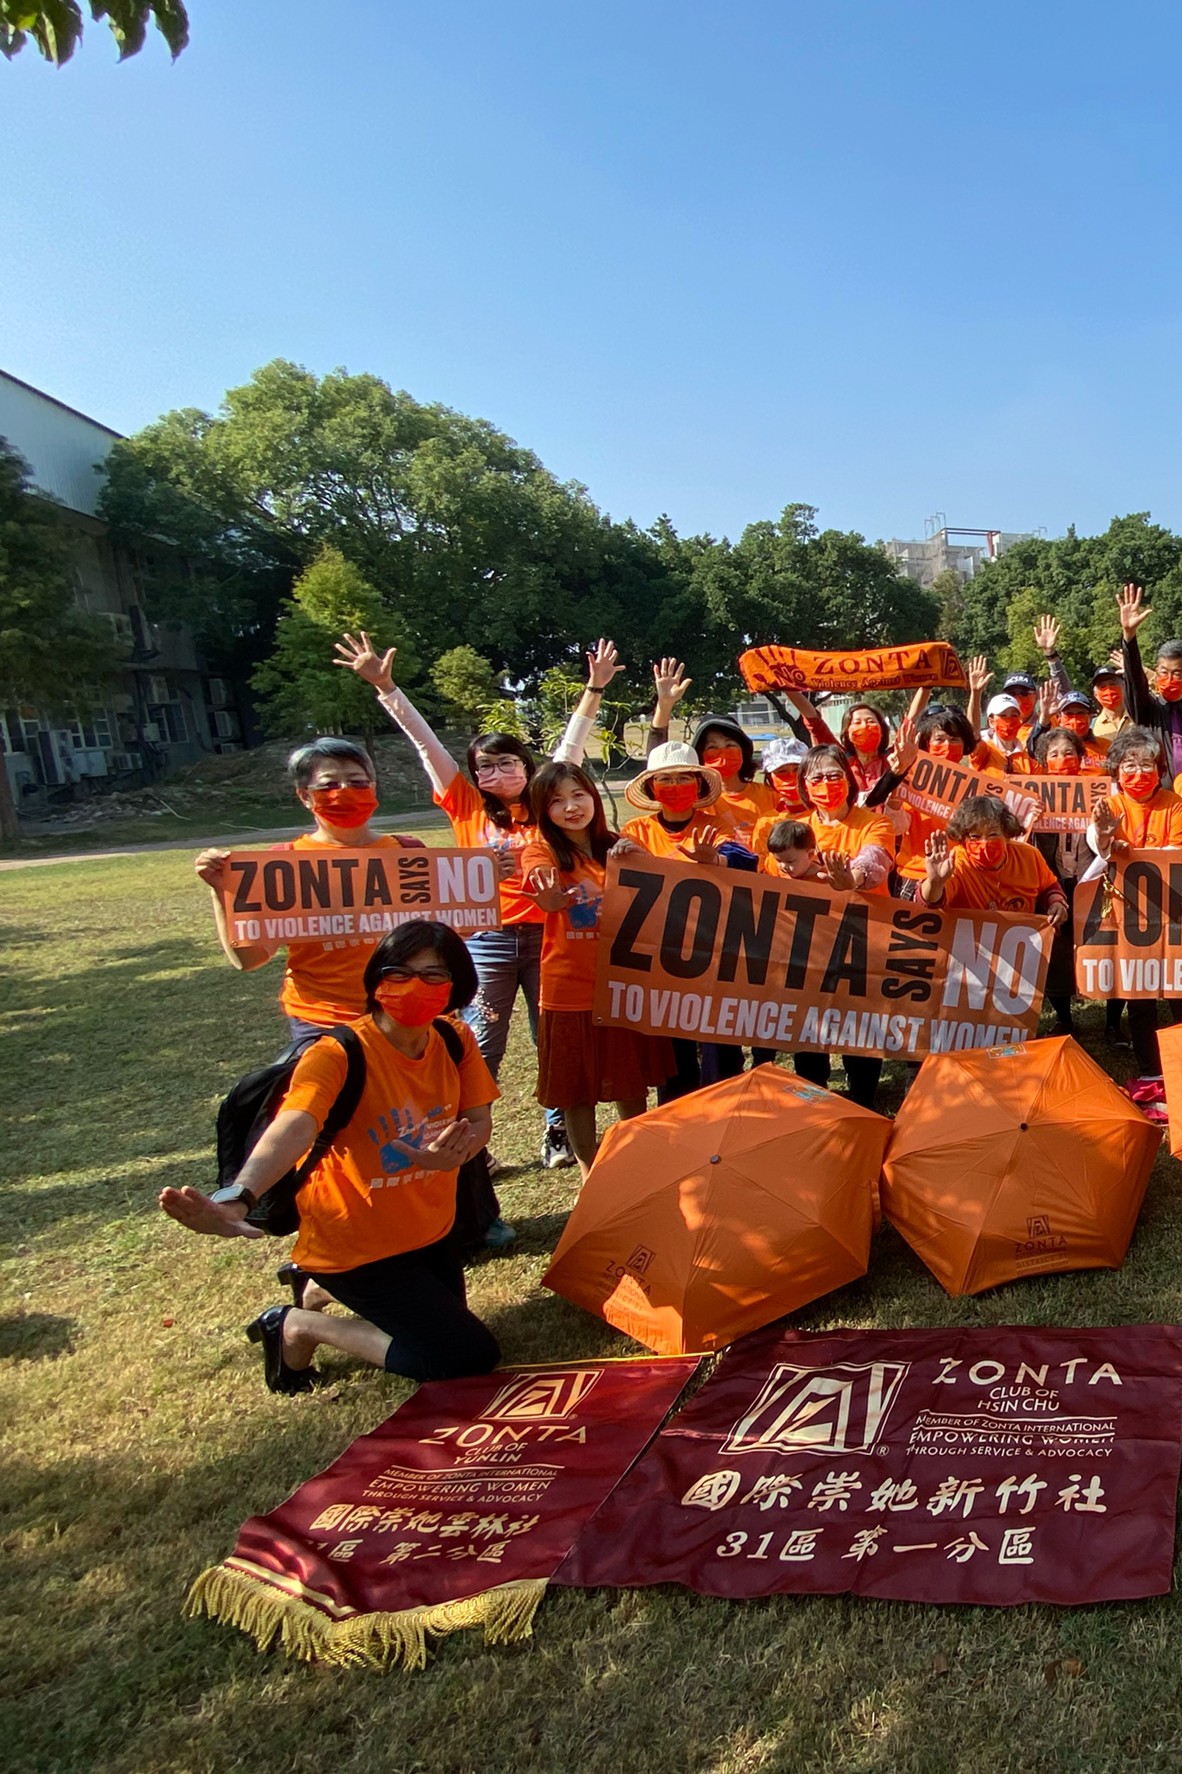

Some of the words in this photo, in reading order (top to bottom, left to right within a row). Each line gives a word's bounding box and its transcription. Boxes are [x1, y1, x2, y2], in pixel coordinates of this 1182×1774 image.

[813, 648, 934, 675] ZONTA
[811, 677, 858, 690] Violence
[903, 759, 979, 802] ONTA
[907, 792, 951, 819] VIOLENCE
[1004, 789, 1036, 822] NO
[1010, 781, 1086, 813] ONTA
[1033, 817, 1067, 830] OLENCE
[1068, 818, 1090, 830] AGAI
[230, 858, 392, 913] ZONTA
[398, 856, 431, 904] SAYS
[436, 855, 495, 904] NO
[235, 920, 261, 941] TO
[264, 913, 355, 939] VIOLENCE
[435, 908, 497, 927] WOMEN
[609, 868, 869, 997] ZONTA
[881, 909, 942, 1002] SAYS
[942, 918, 1043, 1015] NO
[1082, 958, 1114, 993] TO
[608, 980, 642, 1023] TO
[649, 988, 797, 1042] VIOLENCE
[799, 1006, 925, 1054] AGAINST
[1015, 1235, 1068, 1252] ZONTA
[605, 1260, 651, 1296] ZONTA
[932, 1357, 1123, 1387] ZONTA
[977, 1400, 1019, 1413] HSIN
[1022, 1398, 1060, 1412] CHU
[990, 1386, 1031, 1400] CLUB
[1035, 1388, 1059, 1399] OF
[418, 1423, 588, 1449] ZONTA
[909, 1430, 1033, 1445] EMPOWERING
[915, 1414, 961, 1426] MEMBER
[963, 1418, 980, 1426] OF
[981, 1419, 1021, 1431] ZONTA
[1023, 1422, 1116, 1433] INTERNATIONAL
[453, 1452, 522, 1465] YUNLIN
[464, 1443, 502, 1456] CLUB
[505, 1442, 528, 1452] OF
[906, 1444, 967, 1457] THROUGH
[970, 1446, 1021, 1457] SERVICE
[1025, 1449, 1034, 1457] &
[1037, 1448, 1113, 1458] ADVOCACY
[369, 1479, 482, 1493] EMPOWERING
[486, 1480, 551, 1492] WOMEN
[383, 1468, 424, 1480] MEMBER
[425, 1473, 440, 1481] OF
[441, 1470, 476, 1480] ZONTA
[477, 1468, 558, 1478] INTERNATIONAL
[361, 1490, 420, 1501] THROUGH
[421, 1494, 464, 1502] SERVICE
[478, 1493, 544, 1503] ADVOCACY
[681, 1470, 1108, 1519] 國際崇她新竹社
[309, 1503, 541, 1541] 國際崇她雲林社
[379, 1539, 512, 1565] 第二分區
[716, 1527, 824, 1562] 31區
[843, 1524, 1037, 1566] 第一分區
